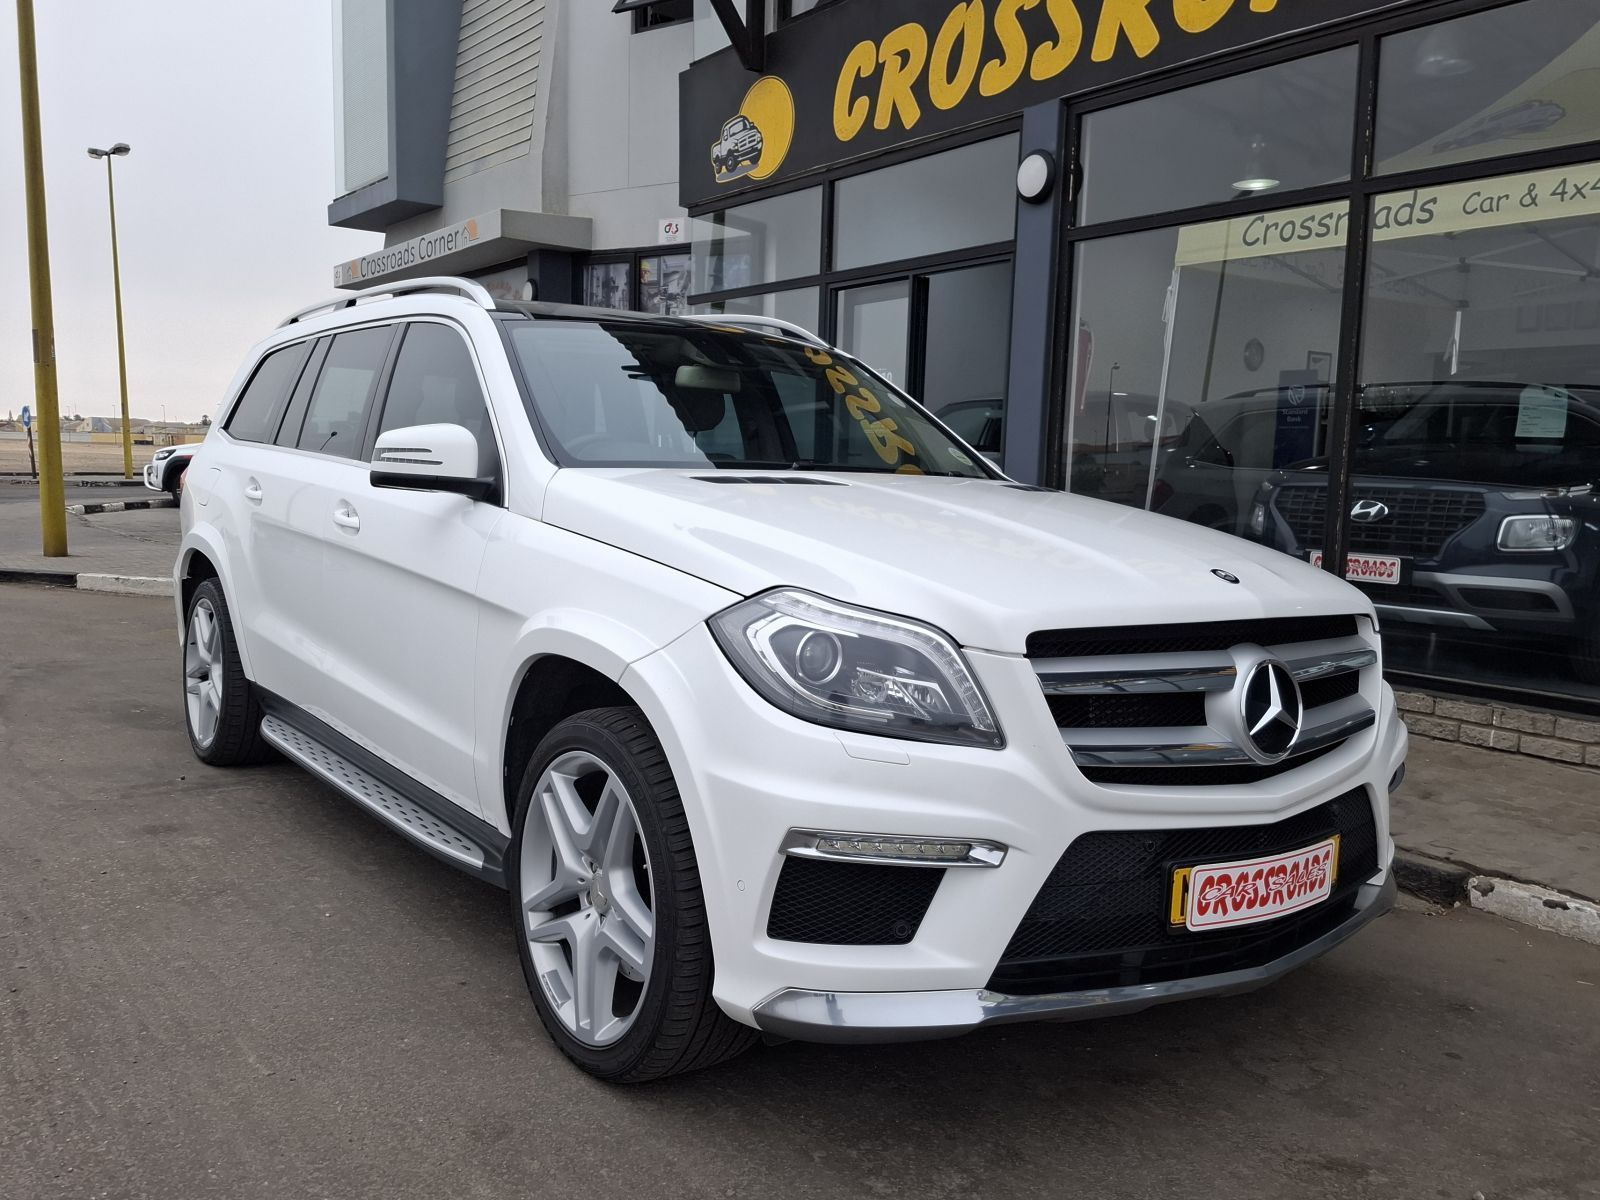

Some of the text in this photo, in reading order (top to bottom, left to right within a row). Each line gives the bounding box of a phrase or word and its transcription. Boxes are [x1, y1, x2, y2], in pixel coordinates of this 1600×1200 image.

[1242, 189, 1438, 247] Crossrads
[1463, 191, 1510, 215] Car
[1519, 182, 1539, 208] &
[360, 229, 460, 278] Crossroads Corner
[1196, 850, 1331, 917] CROSSROADS
[1200, 883, 1257, 903] CAR
[1268, 862, 1328, 893] SALES
